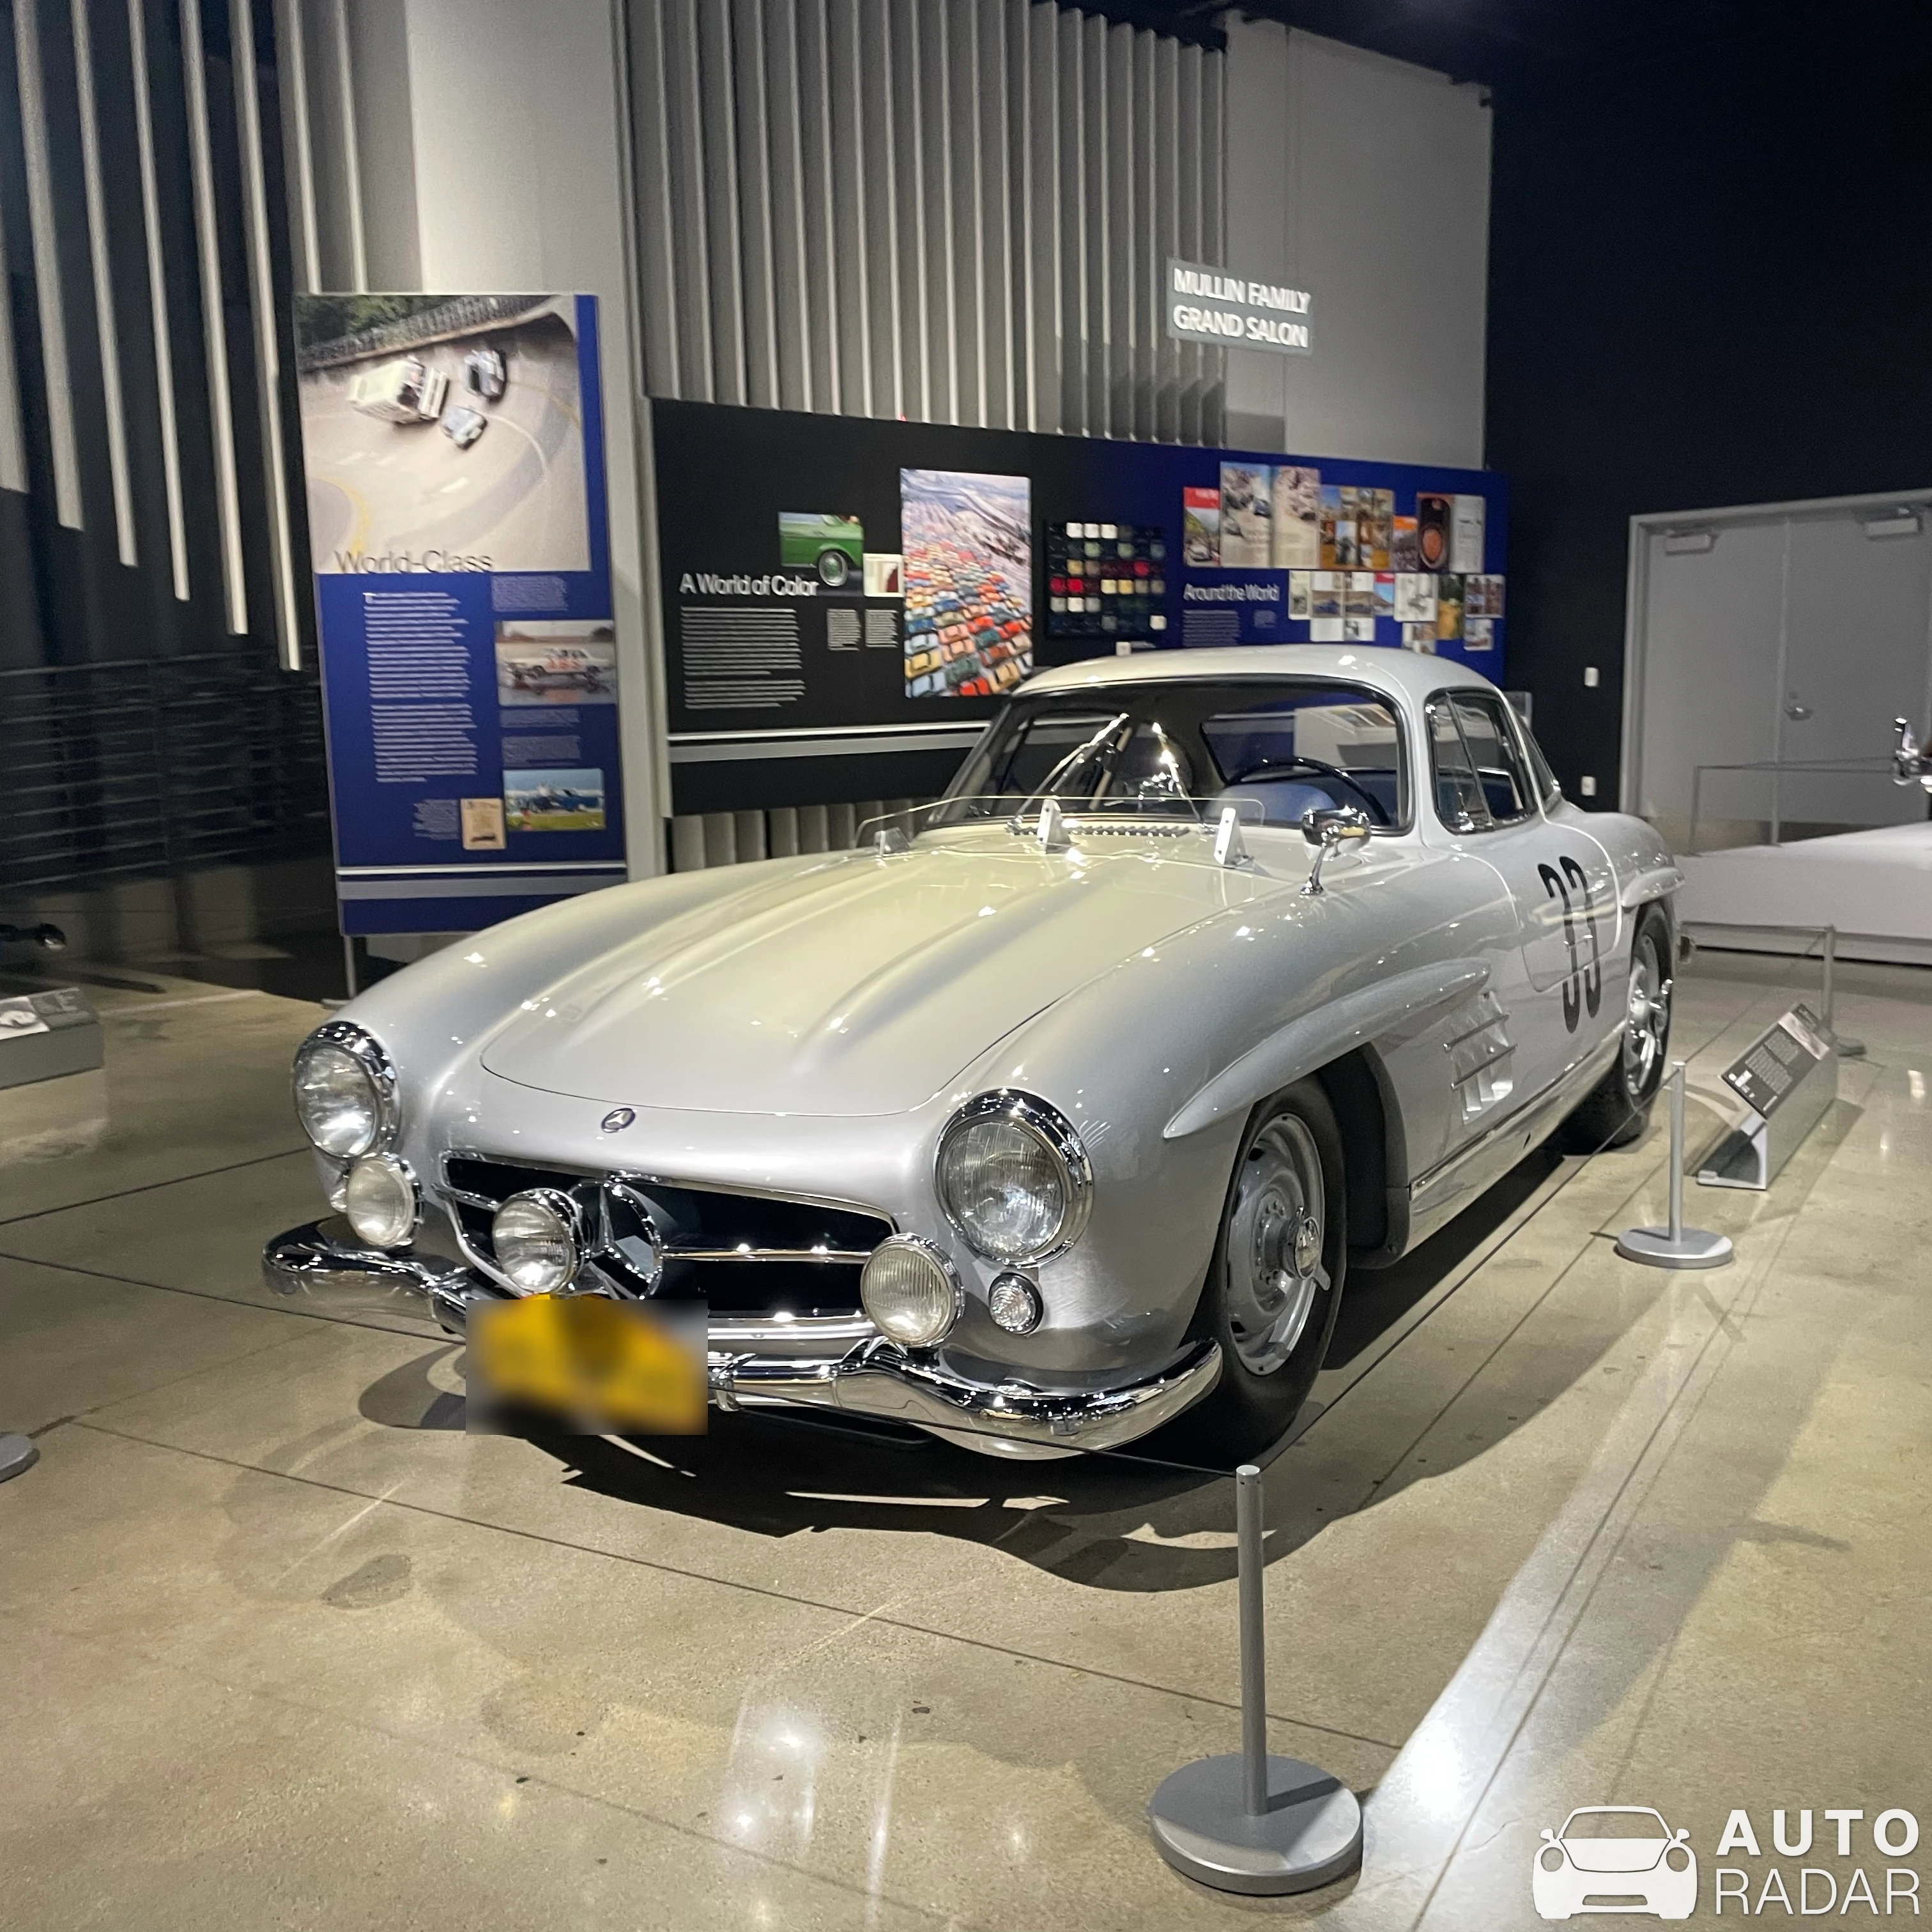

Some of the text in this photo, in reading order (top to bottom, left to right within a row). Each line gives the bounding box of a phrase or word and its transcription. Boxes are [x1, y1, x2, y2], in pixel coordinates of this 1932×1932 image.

[1174, 268, 1310, 314] MULLIN FAMILY
[1173, 305, 1308, 348] GRAND SALON
[334, 549, 493, 574] World-Class
[680, 573, 819, 596] A World of Color
[1183, 583, 1227, 601] Around
[1245, 583, 1280, 601] World
